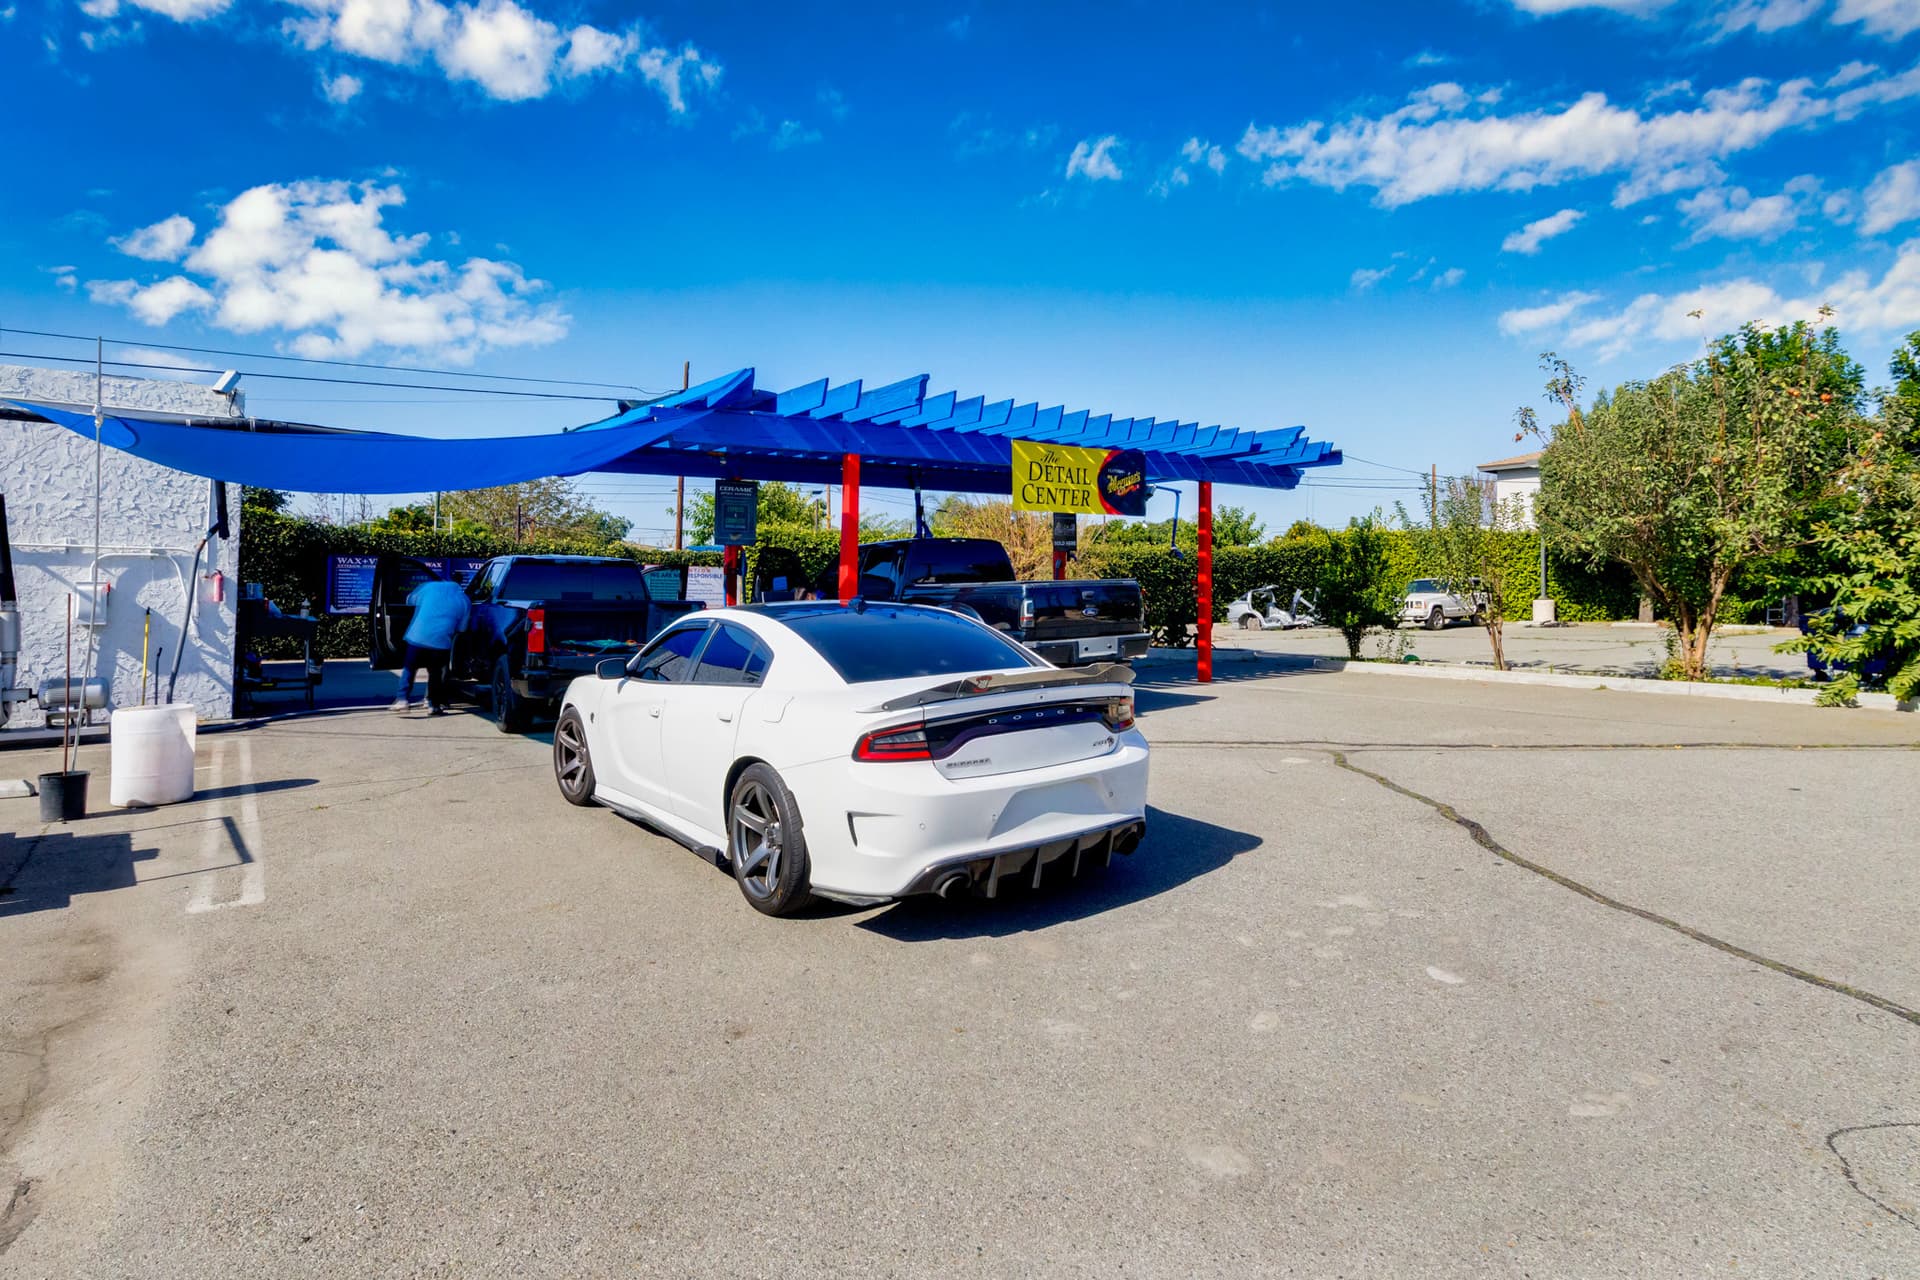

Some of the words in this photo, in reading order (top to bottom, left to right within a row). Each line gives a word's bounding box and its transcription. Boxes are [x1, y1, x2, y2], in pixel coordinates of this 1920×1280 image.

[1040, 450, 1060, 464] The
[1029, 461, 1091, 485] DETAIL
[1022, 484, 1090, 507] CENTER
[988, 706, 1083, 725] DODGE
